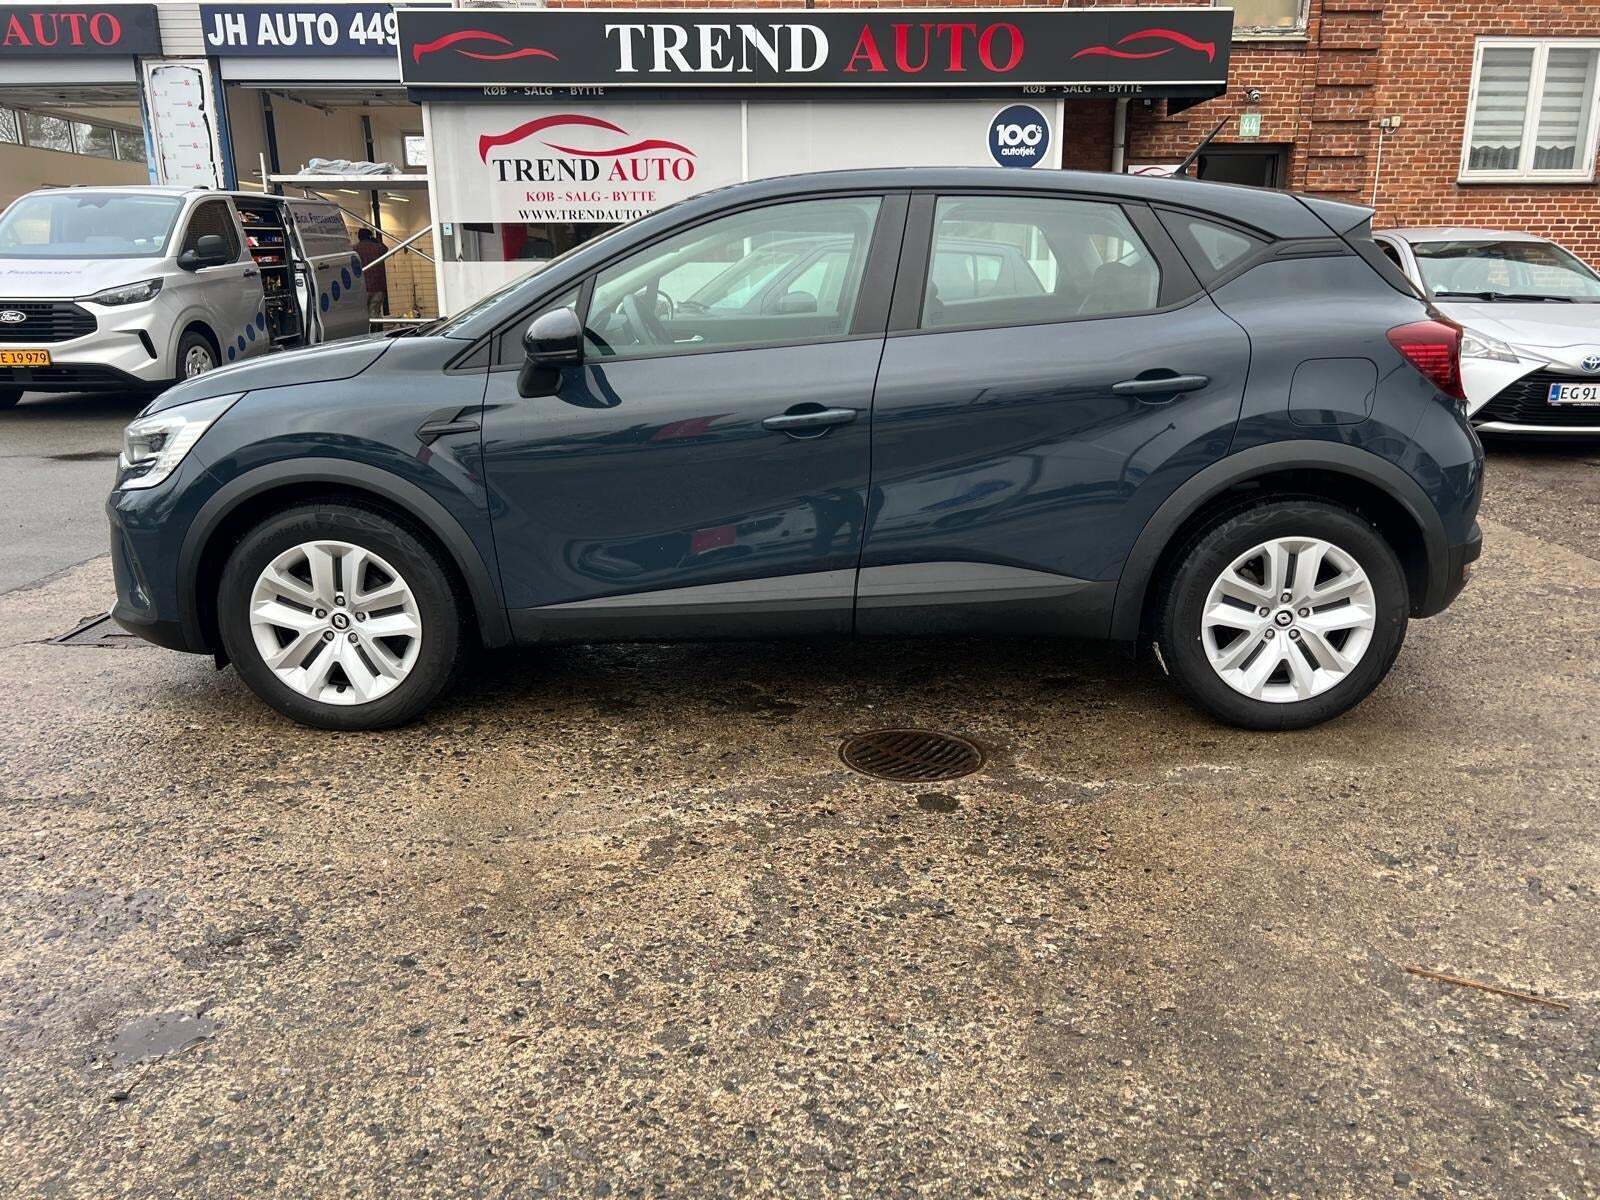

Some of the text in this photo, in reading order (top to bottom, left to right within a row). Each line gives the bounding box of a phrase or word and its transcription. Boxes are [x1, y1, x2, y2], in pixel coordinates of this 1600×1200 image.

[3, 12, 122, 47] AUTO
[207, 12, 399, 46] JH AUTO 449
[605, 22, 1024, 73] TREND AUTO
[483, 85, 507, 96] KØB
[524, 85, 553, 96] SALG
[570, 85, 605, 96] BYTTE
[1063, 85, 1091, 94] SALG
[1109, 85, 1143, 94] BYTTE
[1242, 118, 1256, 133] 44
[1001, 147, 1036, 157] autotjek
[493, 158, 695, 182] TREND AUTO
[526, 191, 555, 202] KØB
[566, 191, 602, 202] SALG
[613, 191, 656, 202] BYTTE
[1, 312, 21, 321] Ford
[12, 352, 23, 363] 19
[26, 352, 47, 363] 979
[1560, 387, 1597, 400] EG 91
